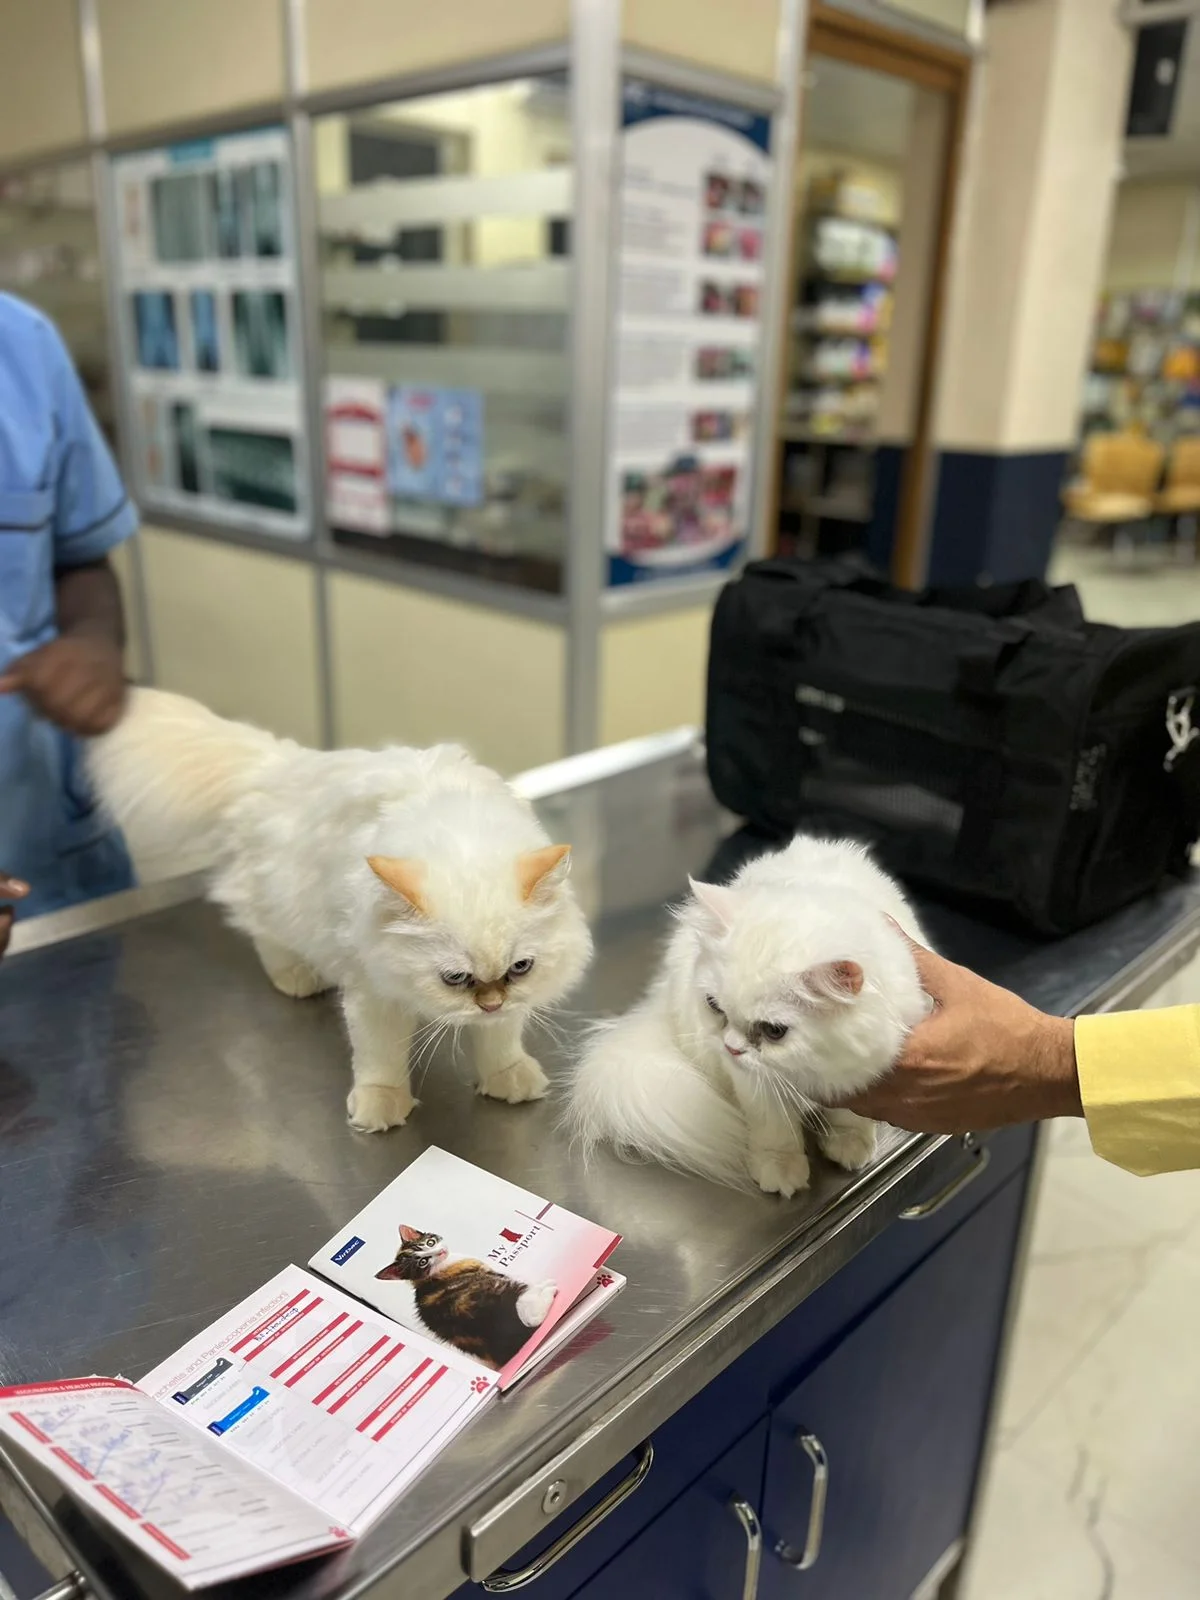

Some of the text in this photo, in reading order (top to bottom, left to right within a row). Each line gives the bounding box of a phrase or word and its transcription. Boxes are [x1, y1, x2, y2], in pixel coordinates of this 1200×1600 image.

[334, 1239, 360, 1260] Virbac
[487, 1243, 507, 1262] My
[498, 1224, 540, 1268] Passport
